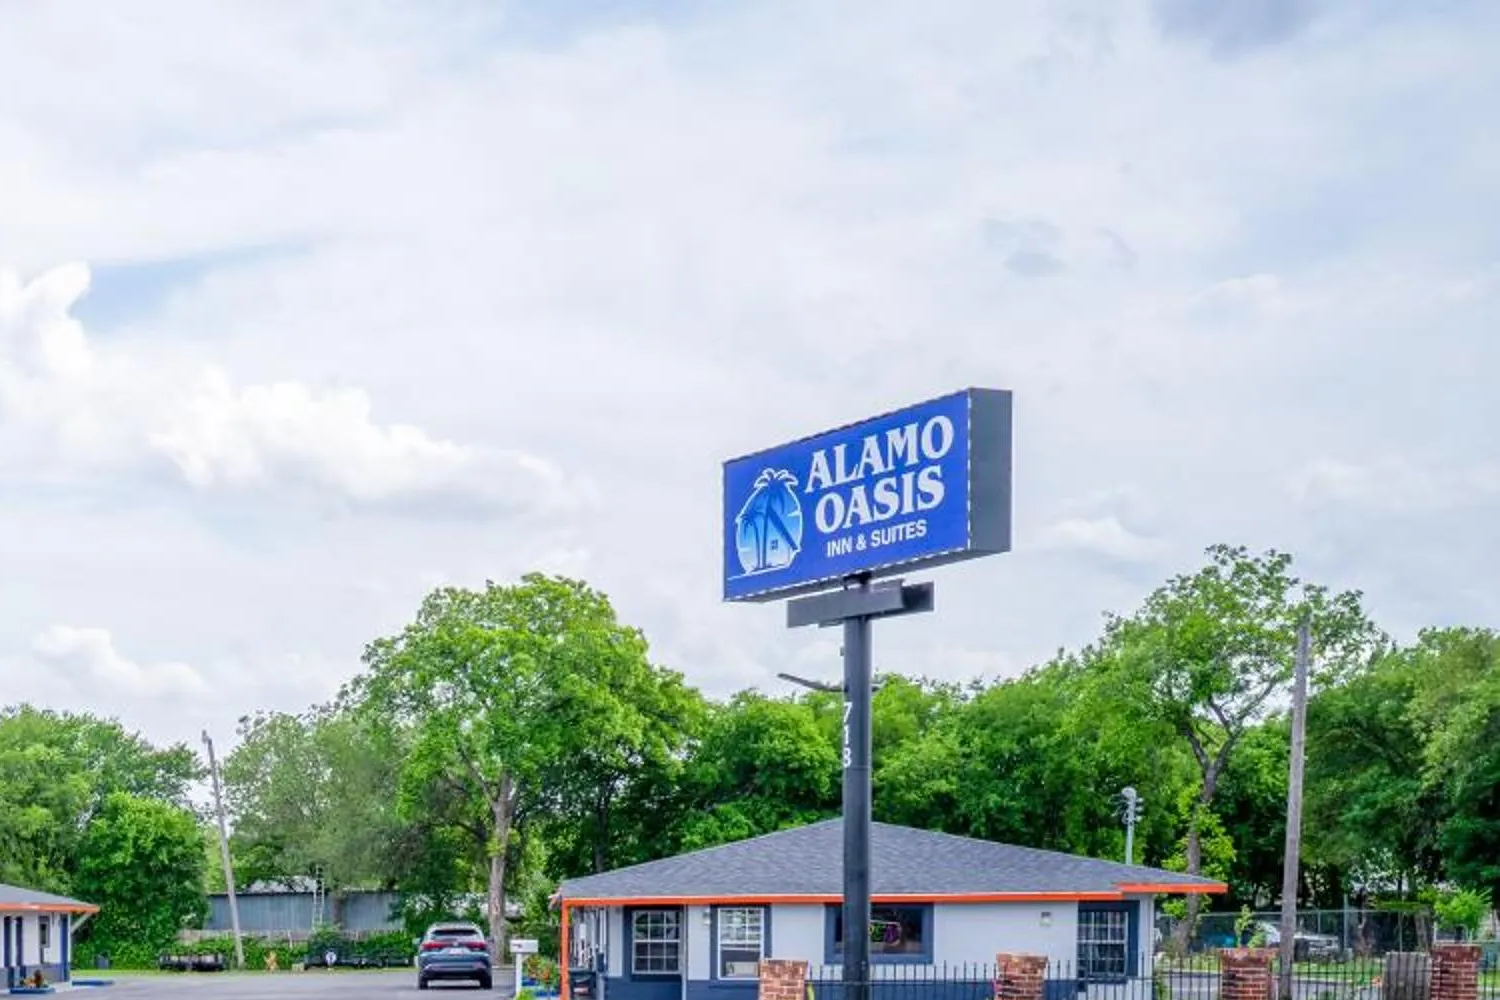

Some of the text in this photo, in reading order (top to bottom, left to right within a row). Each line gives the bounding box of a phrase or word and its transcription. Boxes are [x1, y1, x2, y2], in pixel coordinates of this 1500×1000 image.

[805, 415, 954, 493] ALAMO
[815, 465, 945, 533] OASIS
[827, 519, 927, 558] INN & SUITES
